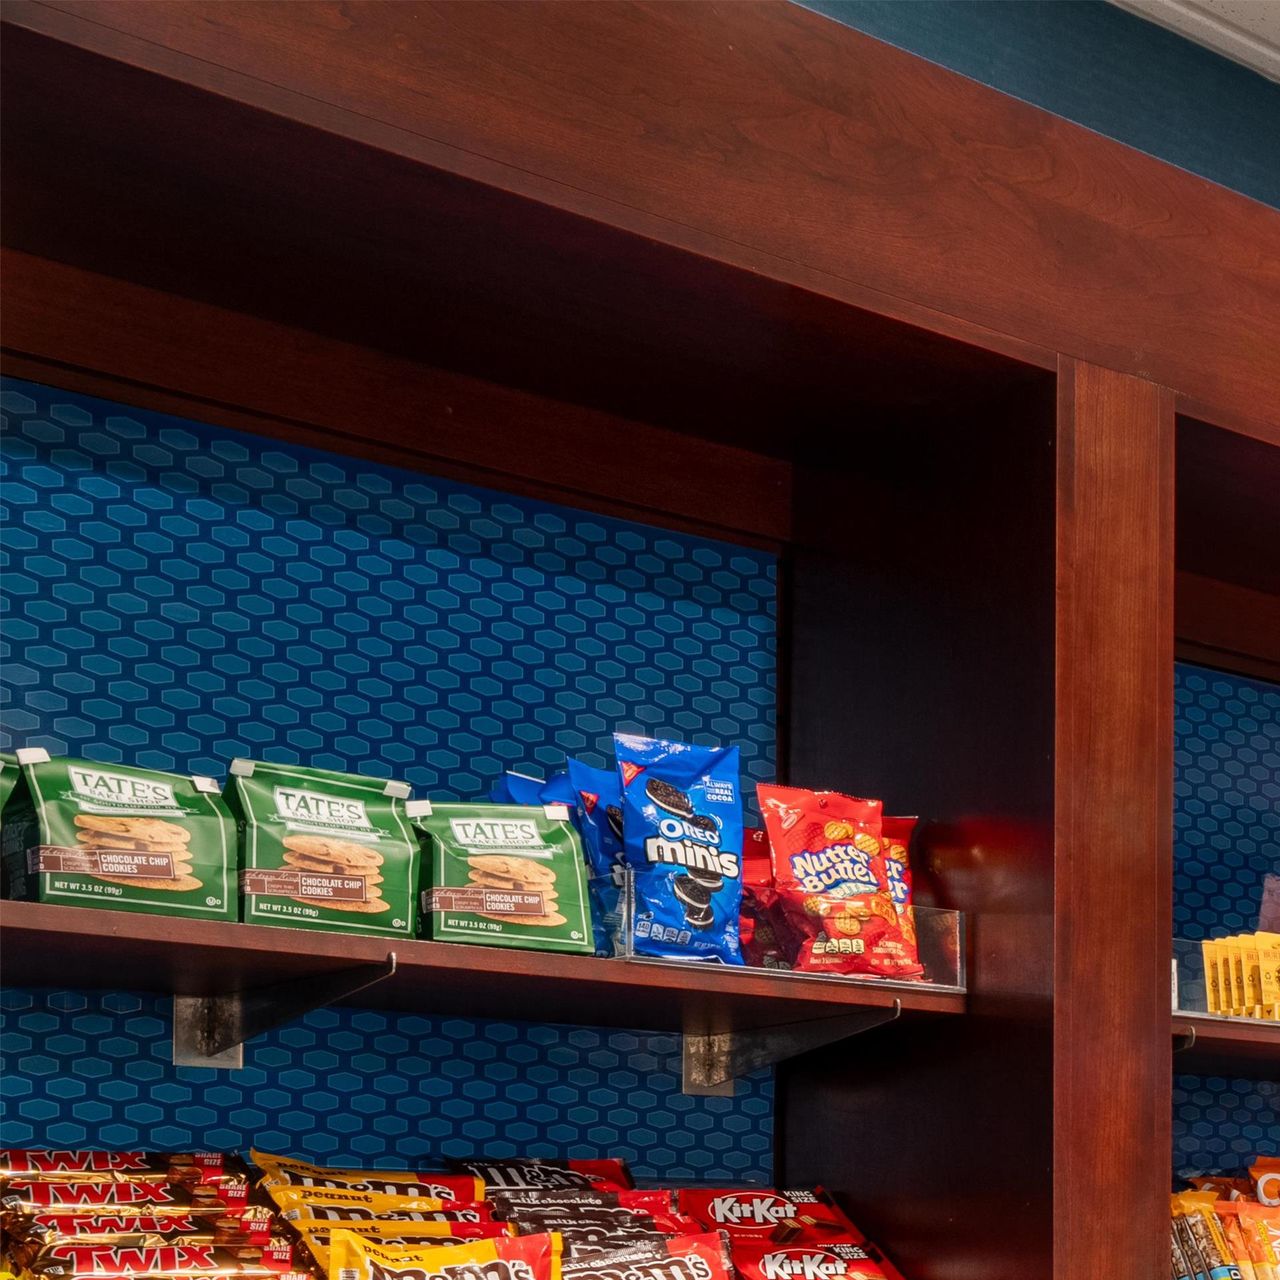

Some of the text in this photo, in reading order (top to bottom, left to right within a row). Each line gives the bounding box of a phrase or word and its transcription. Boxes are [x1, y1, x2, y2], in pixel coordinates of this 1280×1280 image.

[74, 771, 169, 801] TATE'S
[706, 781, 731, 789] ALWAYS
[279, 791, 362, 819] TATE'S
[455, 823, 535, 840] TATE'S
[660, 819, 719, 842] OREO
[101, 855, 147, 865] CHOCOLATE
[149, 856, 168, 866] CHIP
[648, 837, 740, 877] minis
[793, 845, 869, 879] Nutter
[103, 864, 138, 873] COOKIES
[302, 877, 361, 888] CHOCOLATE CHIP
[804, 864, 878, 893] Butter
[302, 886, 333, 896] COOKIES
[486, 893, 523, 903] CHOCOLATE
[487, 902, 515, 911] COOKIES
[204, 1158, 222, 1166] SIZE
[9, 1182, 174, 1207] TWIX
[228, 1190, 246, 1198] SIZE
[301, 1189, 372, 1202] peanut
[34, 1215, 199, 1235] TWIX
[250, 1222, 268, 1231] SIZE
[51, 1245, 220, 1274] TWIX
[272, 1251, 291, 1260] SIZE
